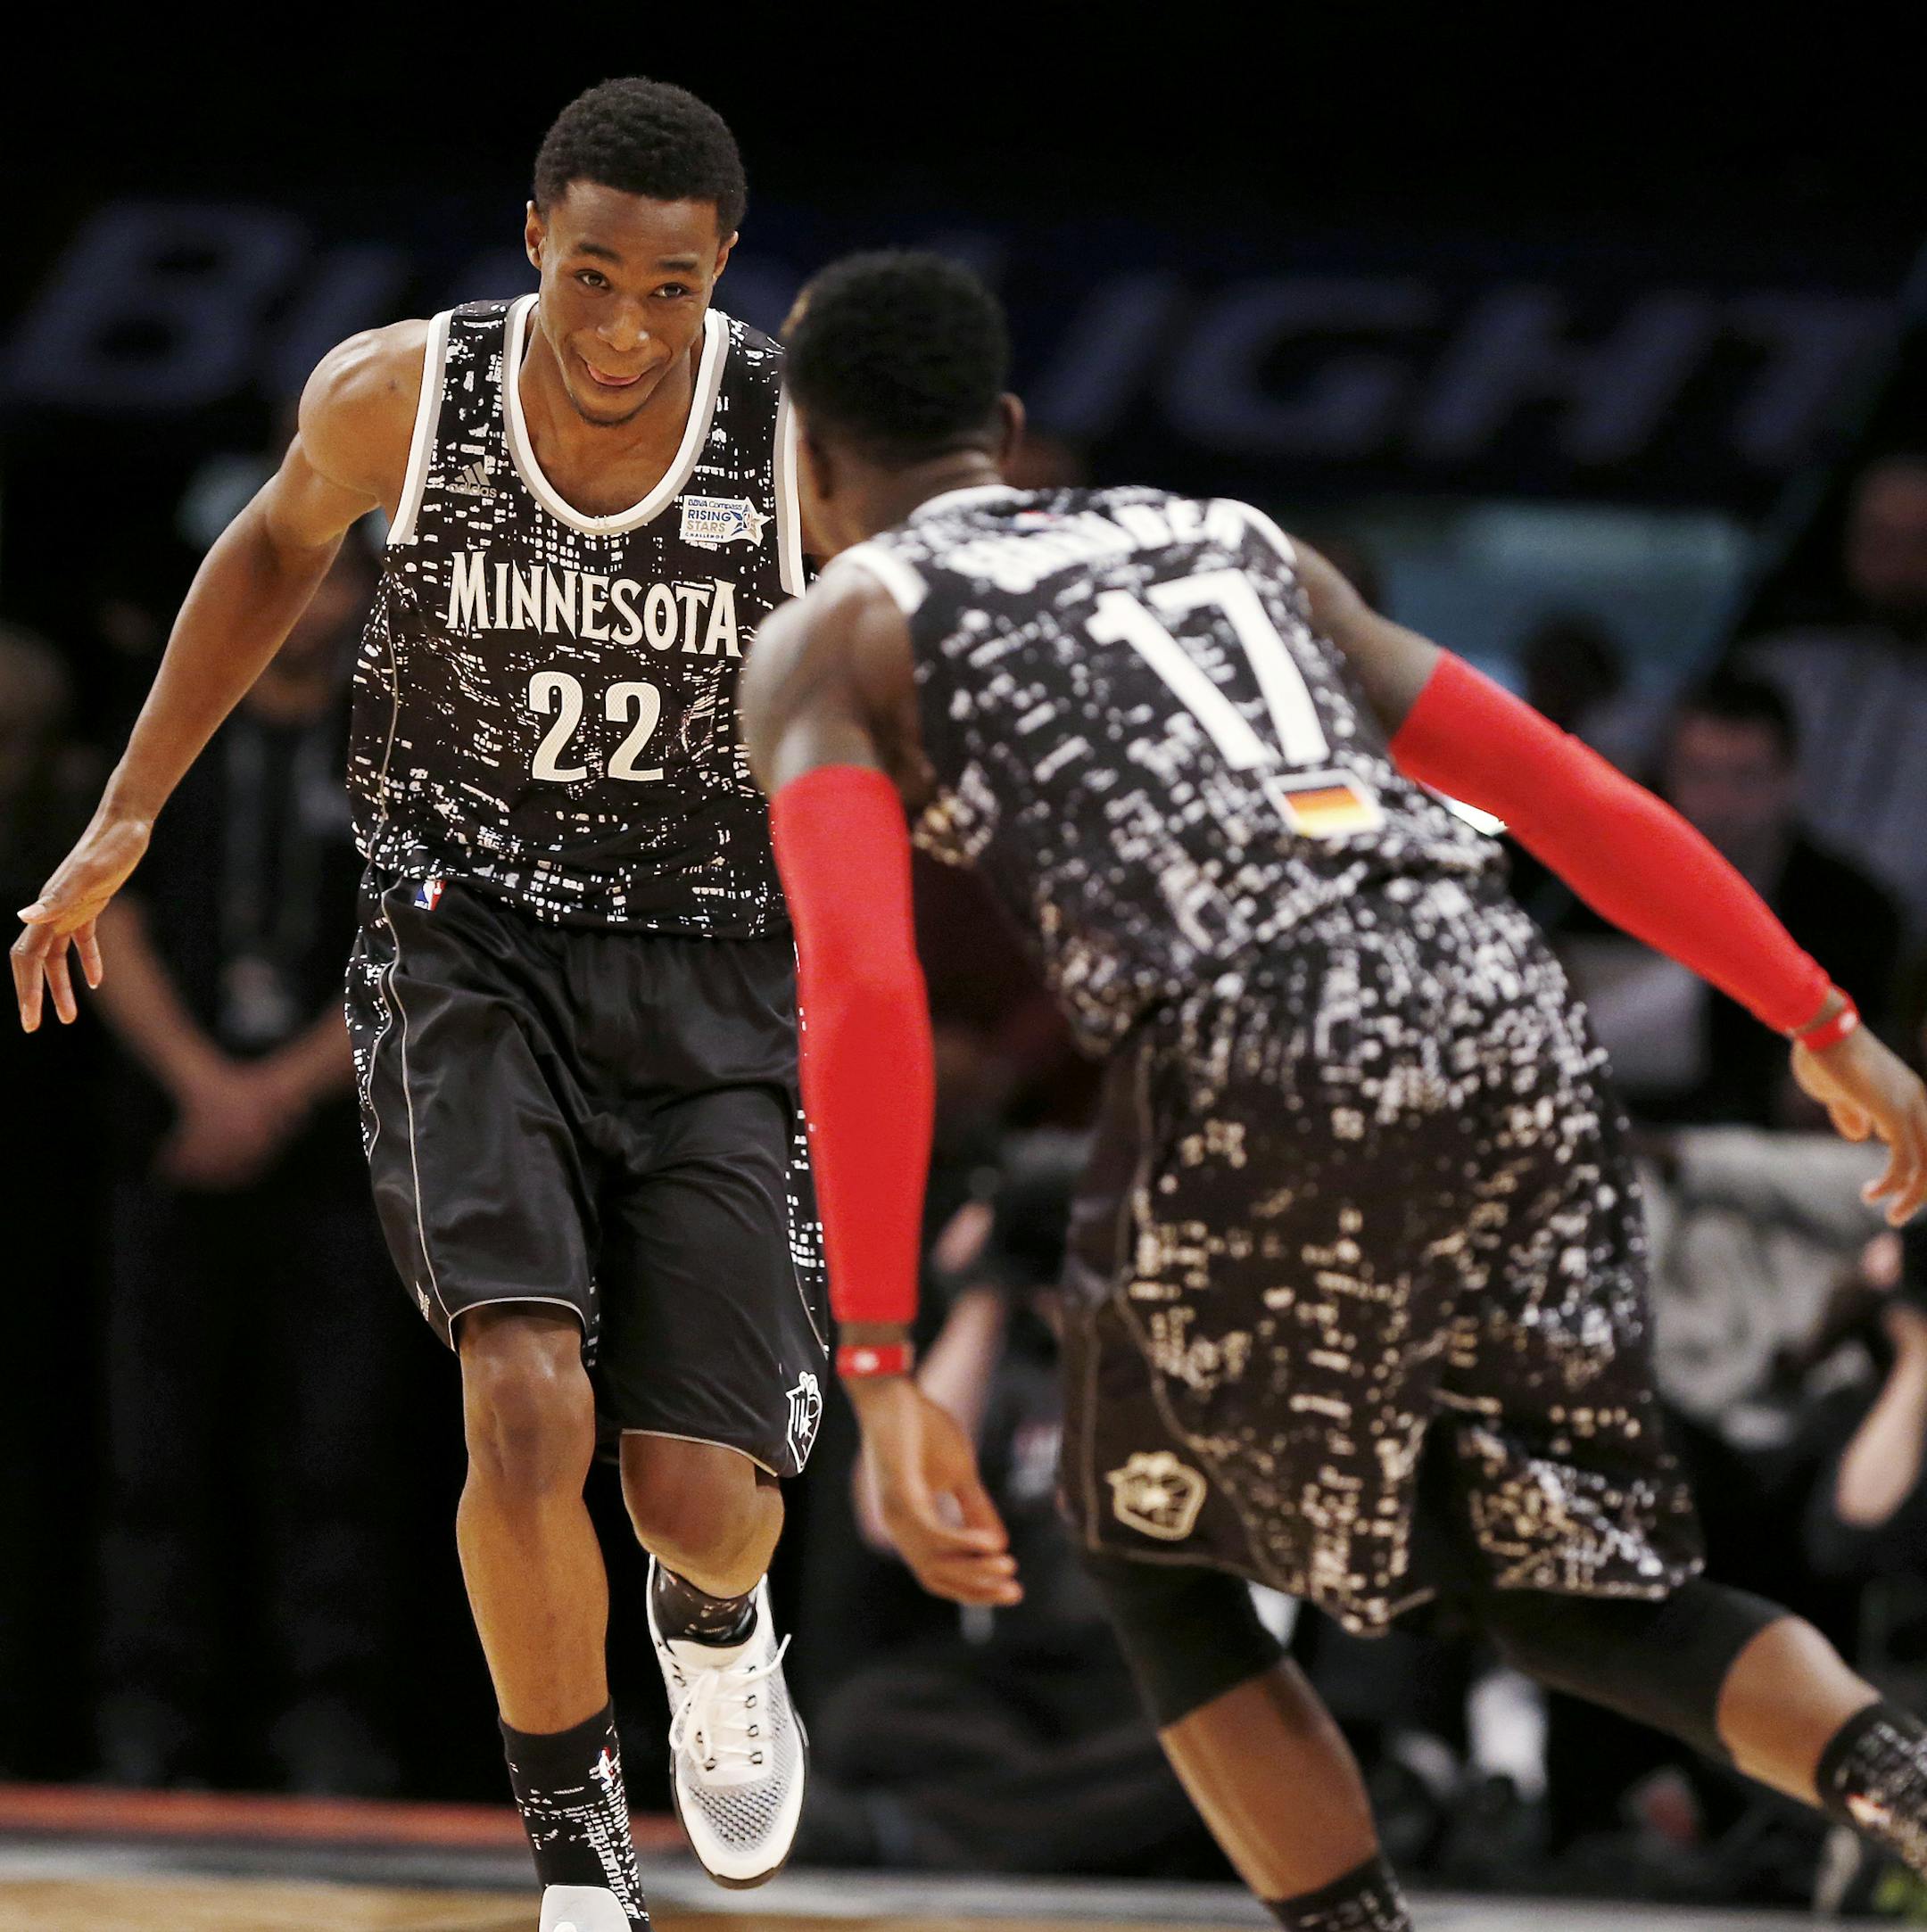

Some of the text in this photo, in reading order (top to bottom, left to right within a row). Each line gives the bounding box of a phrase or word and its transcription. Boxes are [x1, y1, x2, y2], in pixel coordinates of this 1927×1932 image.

[930, 227, 1891, 464] IGHT
[448, 482, 498, 499] adidas
[688, 499, 743, 511] BBVA Compass
[688, 509, 732, 522] RISING
[686, 520, 726, 533] STARS
[684, 532, 724, 540] CHALLENGE
[446, 549, 743, 658] MINNESOTA
[1085, 566, 1330, 771] 17
[528, 670, 665, 782] 22
